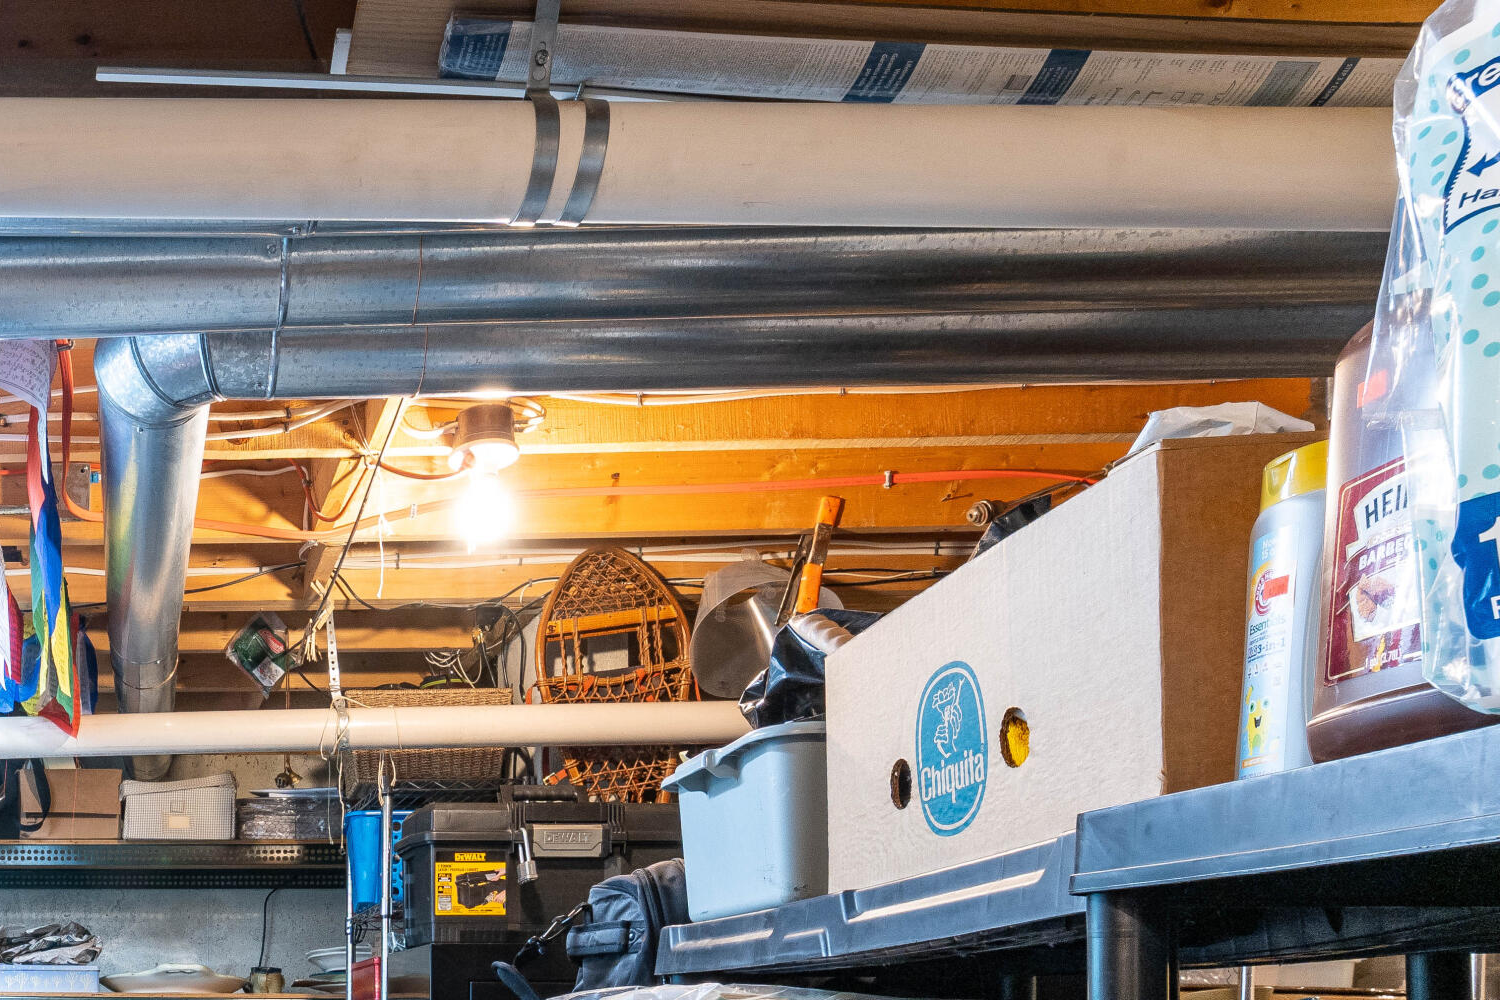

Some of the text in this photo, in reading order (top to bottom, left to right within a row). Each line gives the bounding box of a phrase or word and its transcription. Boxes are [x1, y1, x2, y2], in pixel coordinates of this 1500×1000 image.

[1365, 483, 1408, 529] HEI
[921, 749, 985, 804] Chiquita
[455, 852, 486, 862] DEWALT
